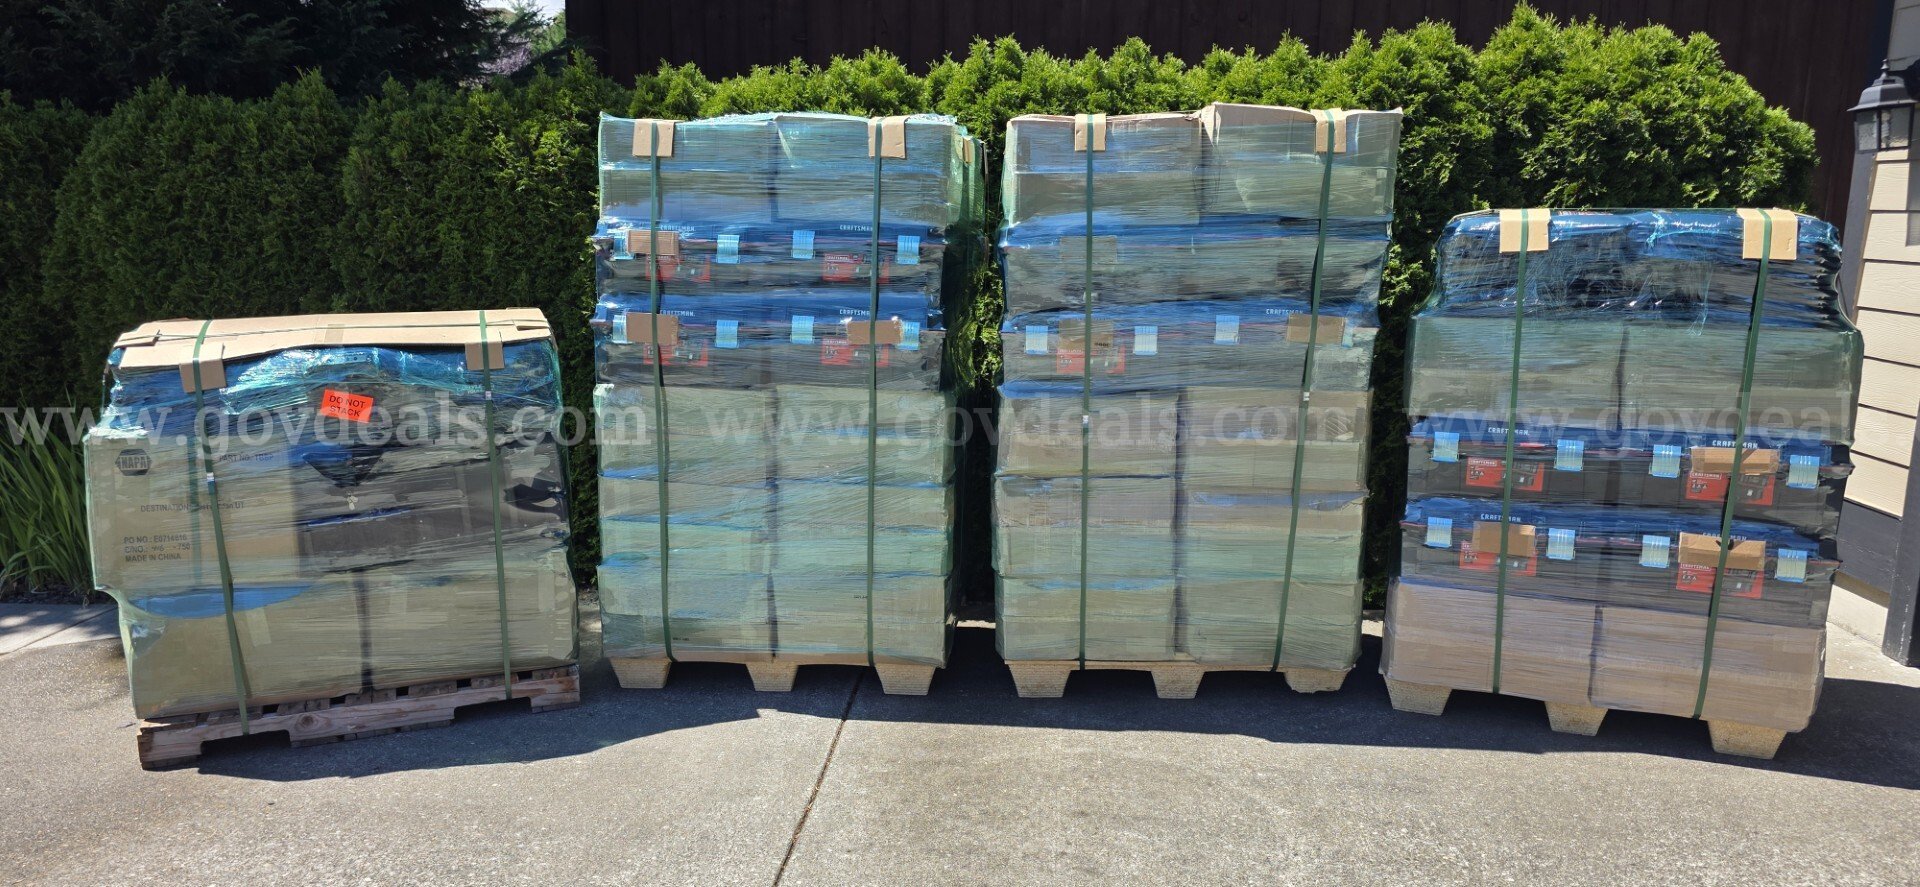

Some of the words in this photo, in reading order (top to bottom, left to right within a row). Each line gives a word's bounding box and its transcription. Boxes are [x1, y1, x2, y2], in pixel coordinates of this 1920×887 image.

[329, 395, 344, 404] DO
[346, 398, 366, 409] NOT
[330, 405, 361, 417] STACK
[1487, 426, 1530, 436] CRAFTMAN
[1712, 439, 1759, 449] CRAFTMAN
[120, 455, 149, 470] NAPA
[1480, 512, 1522, 522] CRAFTAN
[125, 554, 148, 562] MADE
[158, 552, 182, 561] CHINA
